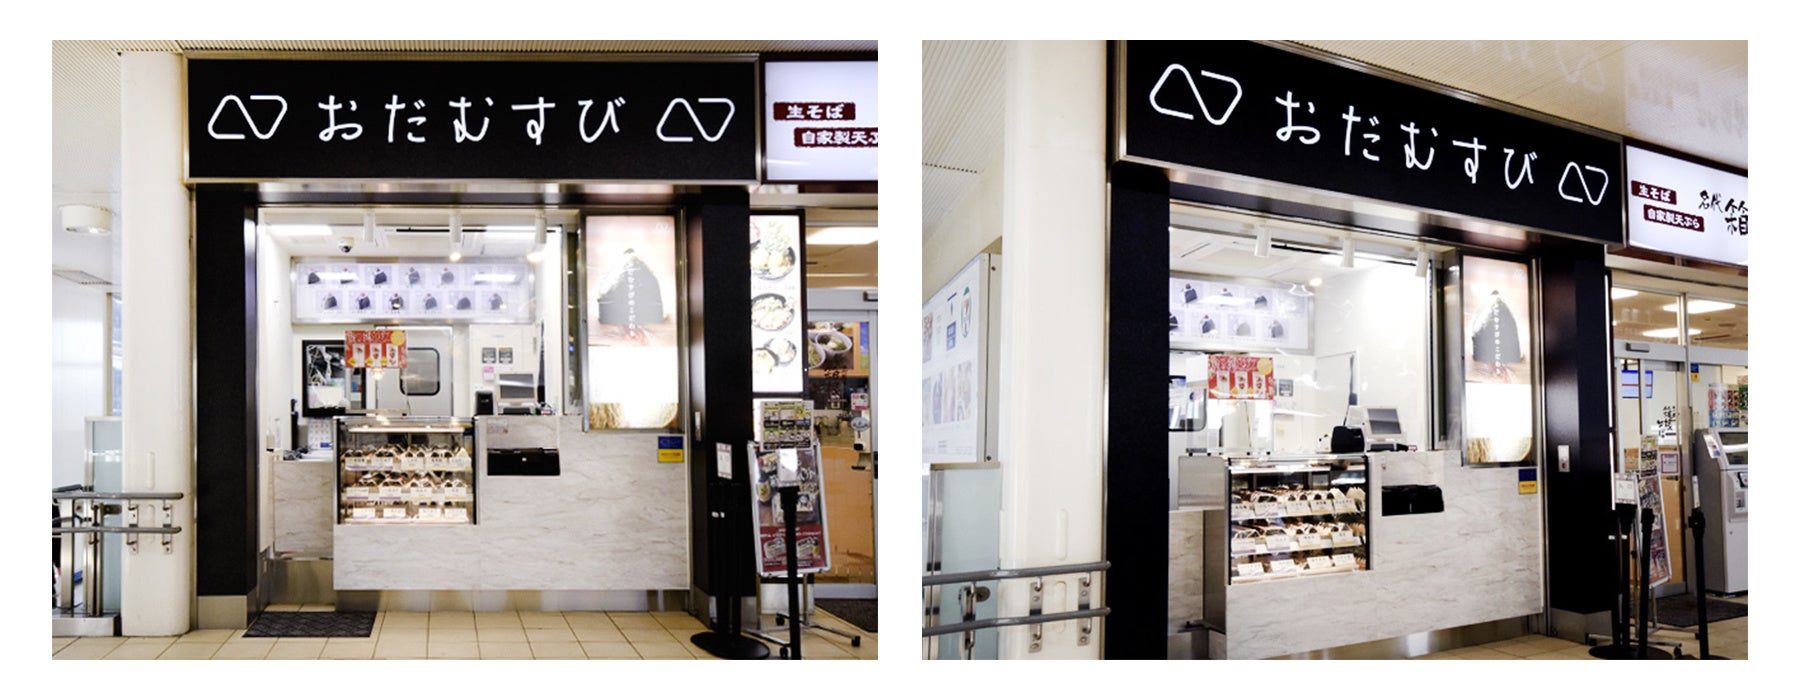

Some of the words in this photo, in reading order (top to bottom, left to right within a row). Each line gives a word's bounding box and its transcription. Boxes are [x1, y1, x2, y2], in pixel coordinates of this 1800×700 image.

[318, 94, 626, 146] おだむすび
[785, 104, 845, 119] 生そば
[1275, 90, 1538, 190] おだむすび
[1638, 183, 1672, 202] 生そば
[1646, 207, 1701, 230] 自家製天ぷら
